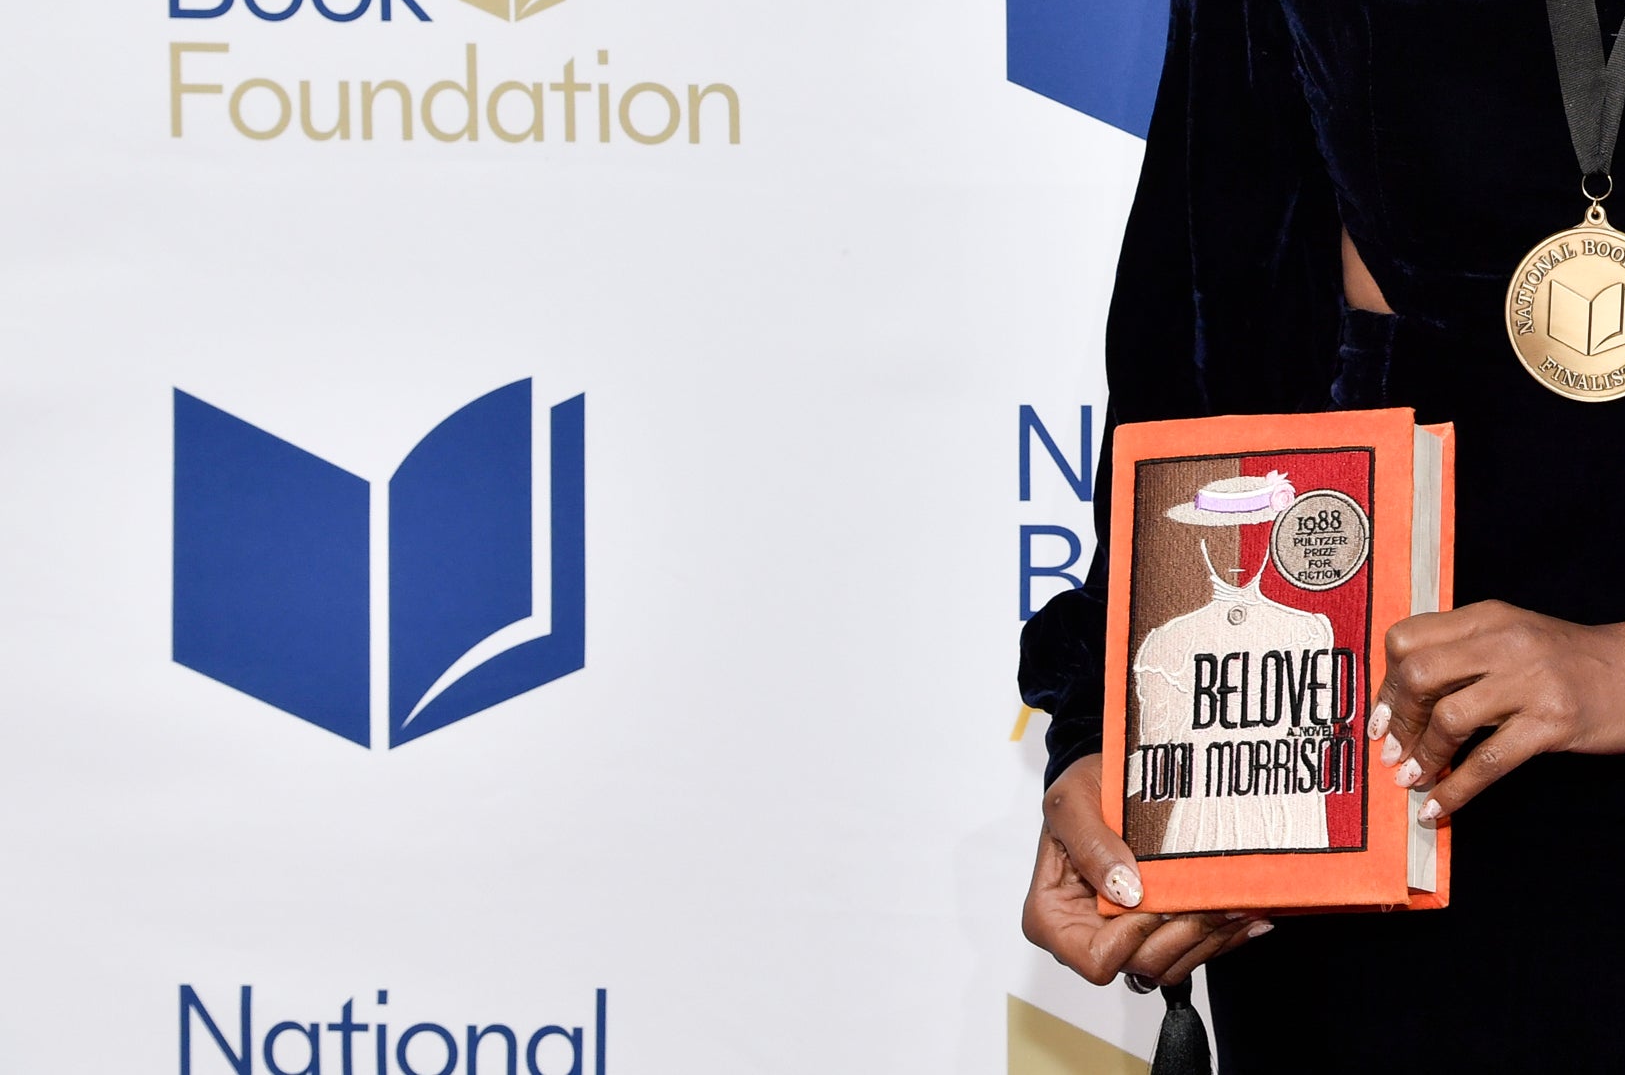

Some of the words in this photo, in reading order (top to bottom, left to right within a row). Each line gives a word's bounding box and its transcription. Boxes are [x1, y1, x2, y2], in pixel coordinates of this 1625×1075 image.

[169, 42, 740, 145] Foundation
[1516, 243, 1576, 336] NATIONAL
[1293, 536, 1348, 547] PULITZER
[1296, 510, 1343, 536] 1988
[1298, 569, 1341, 580] FICTION
[1304, 547, 1337, 558] PRIZE
[1308, 558, 1332, 569] FOR
[1192, 649, 1356, 730] BELOVED
[1205, 736, 1356, 798] MORRISON
[179, 984, 607, 1075] National
